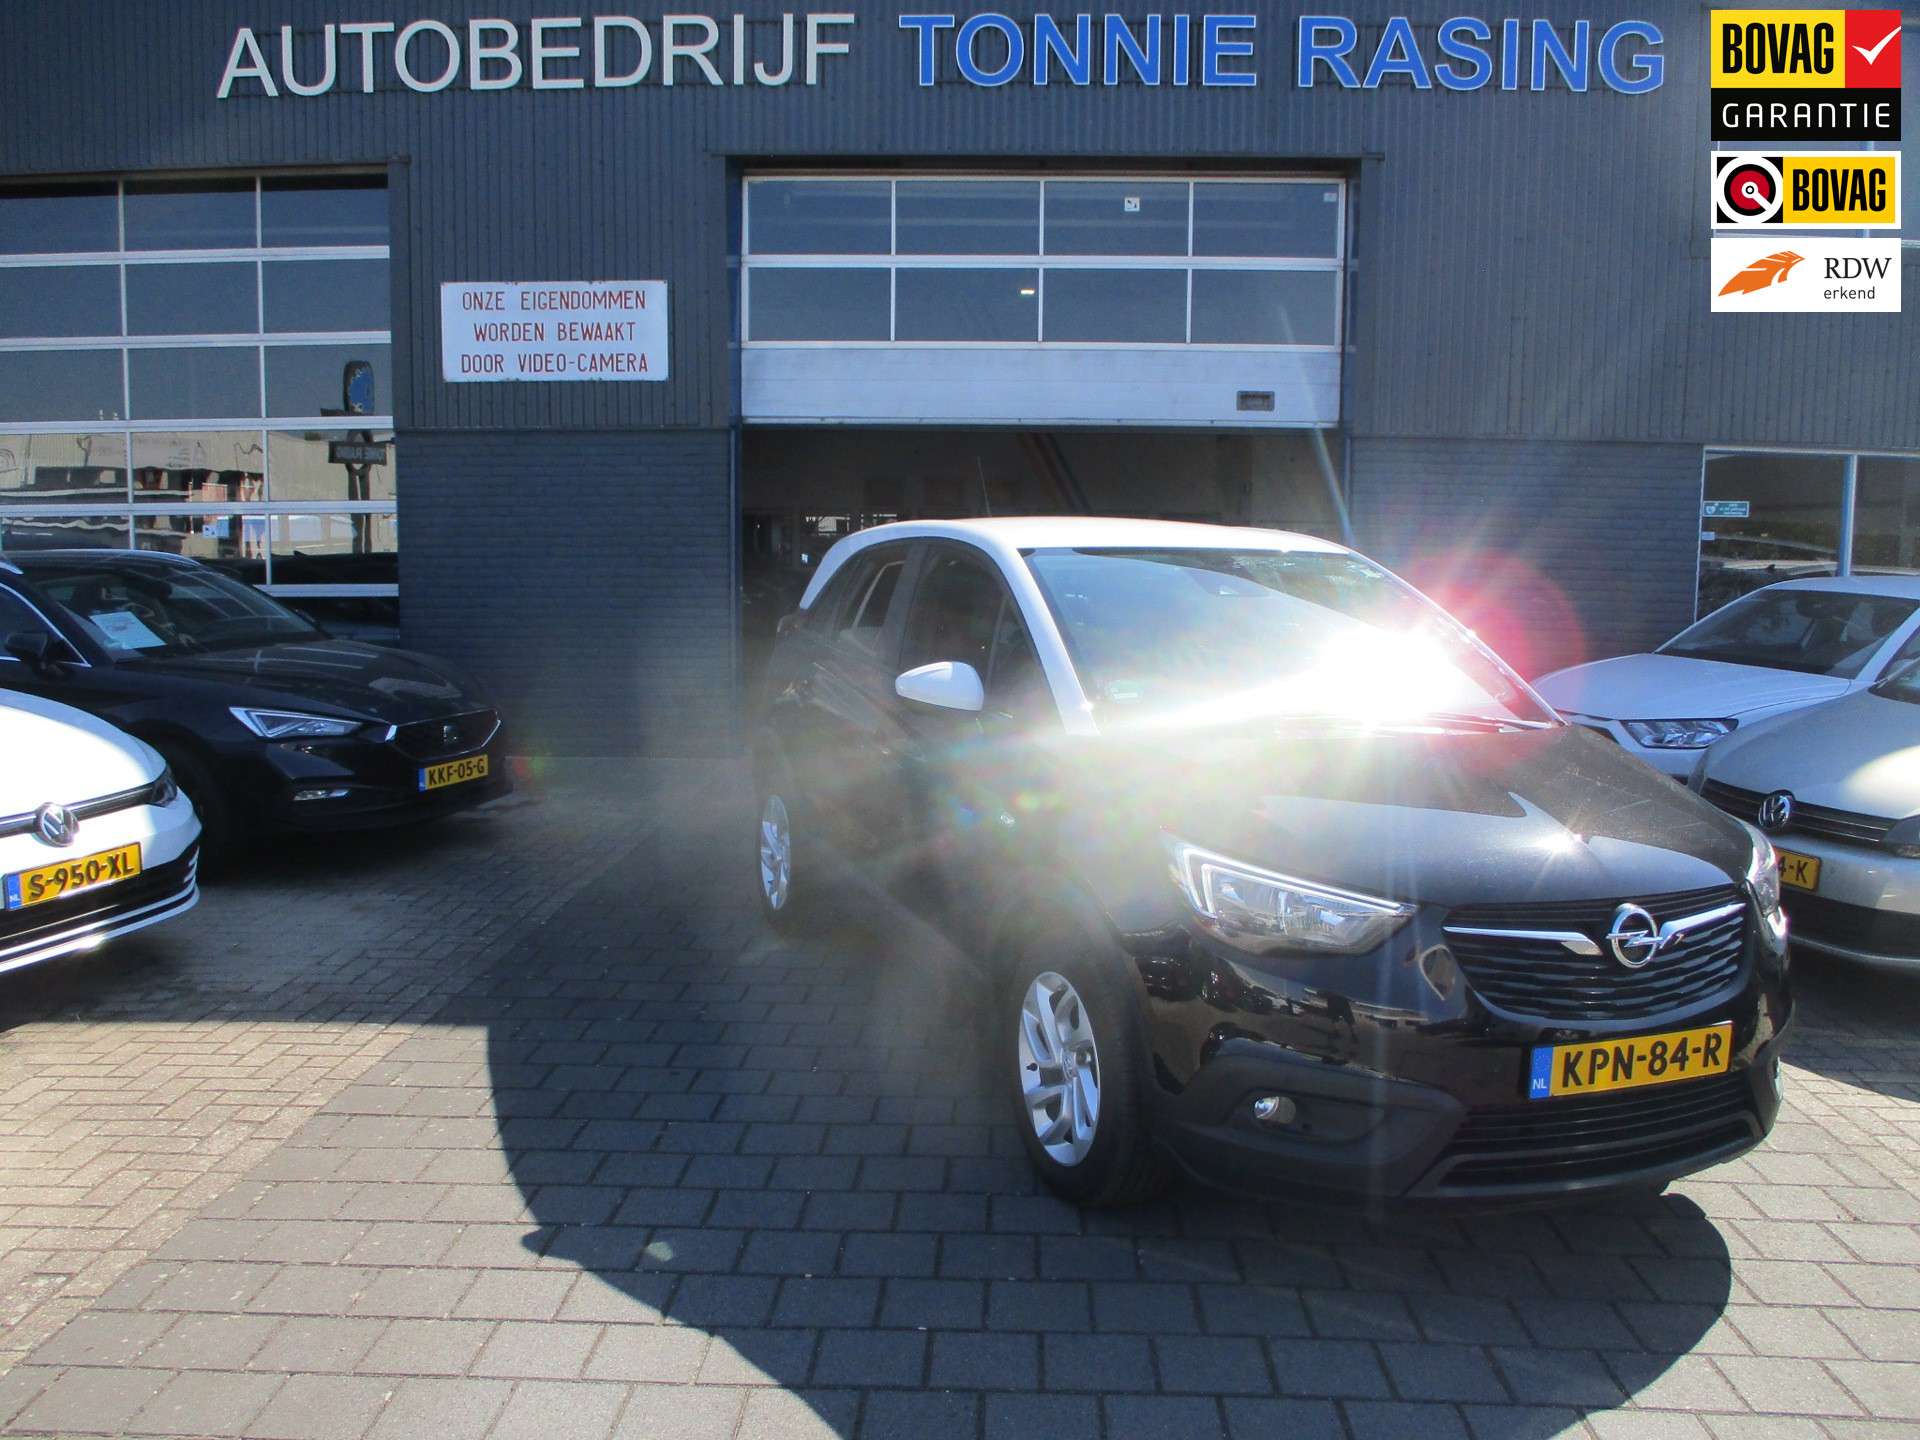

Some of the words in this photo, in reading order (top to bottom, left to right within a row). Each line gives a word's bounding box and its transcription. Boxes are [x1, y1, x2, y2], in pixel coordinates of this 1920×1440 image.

[216, 13, 855, 99] AUTOBEDRIJF
[898, 13, 1257, 87] TONNIE
[1298, 16, 1665, 95] RASING
[462, 291, 506, 311] ONZE
[520, 290, 646, 311] EIGENDOMMEN
[473, 322, 545, 342] WORDEN
[557, 321, 636, 342] BEWAAKT
[461, 353, 505, 373] DOOR
[517, 352, 649, 373] VIDEO-CAMERA
[428, 758, 485, 785] KKF-05-G
[28, 851, 134, 900] S-950-XL
[1532, 1078, 1547, 1089] NL
[1562, 1032, 1722, 1088] KPN-84-R
